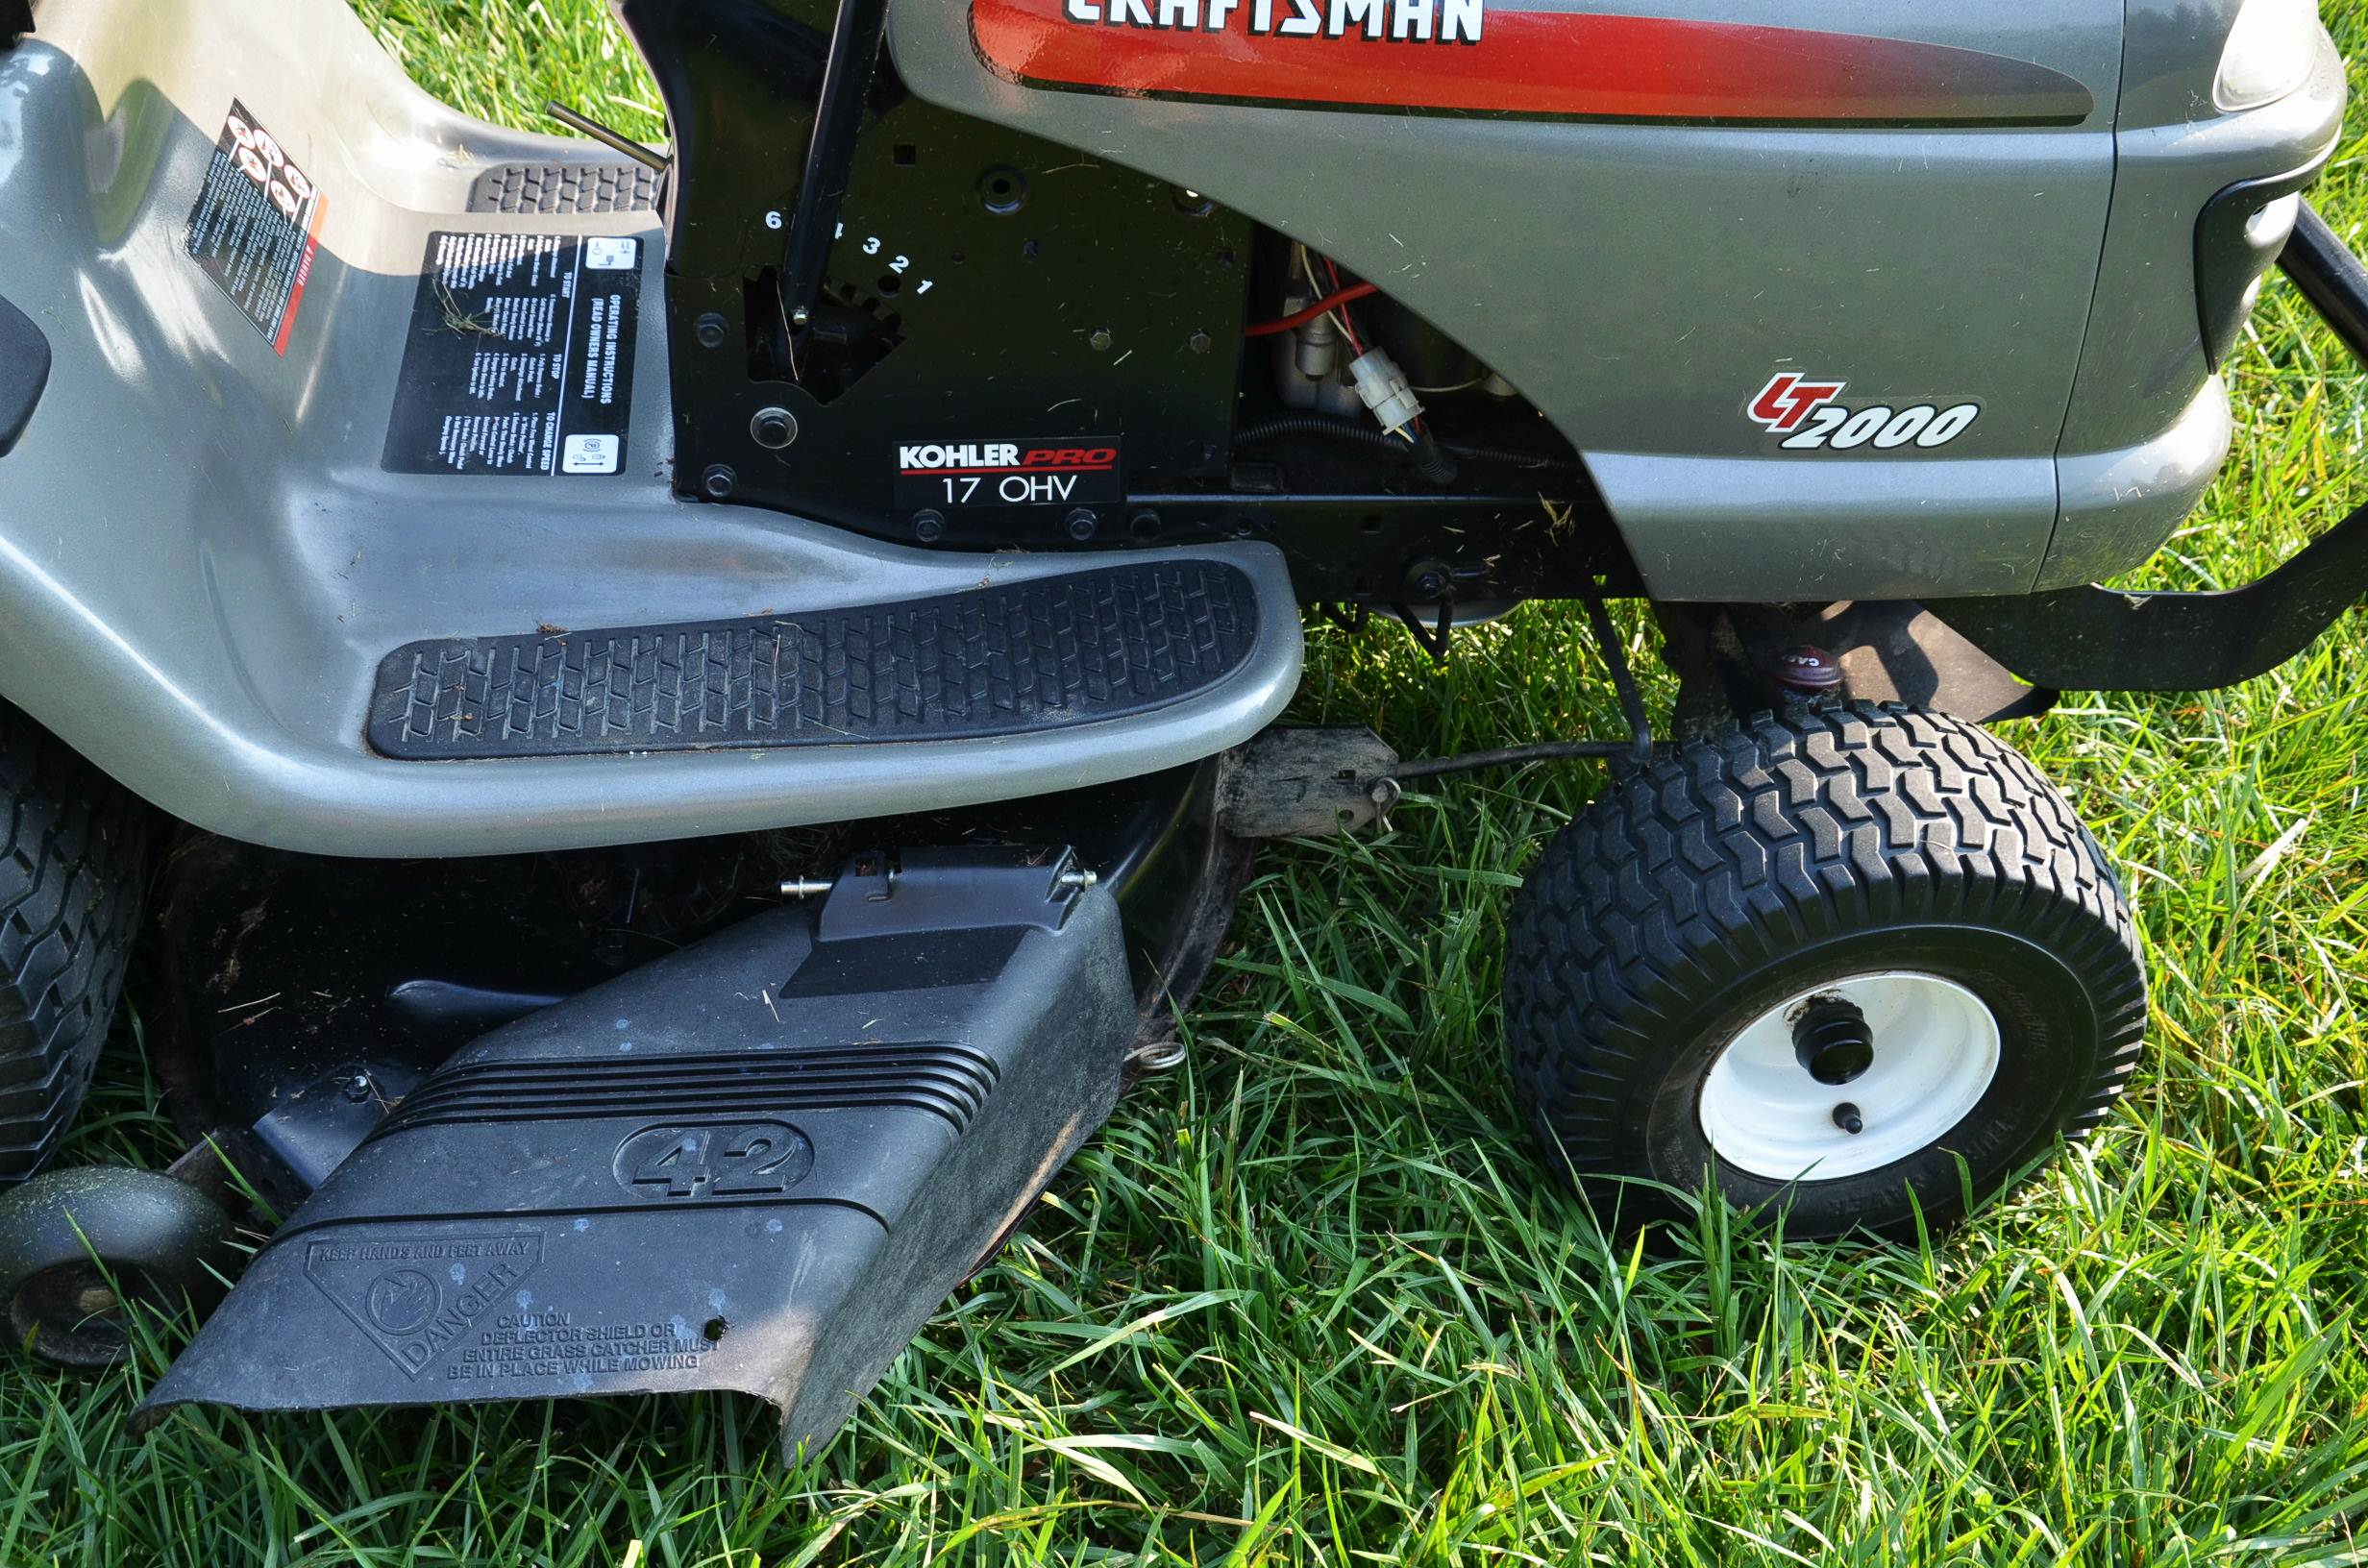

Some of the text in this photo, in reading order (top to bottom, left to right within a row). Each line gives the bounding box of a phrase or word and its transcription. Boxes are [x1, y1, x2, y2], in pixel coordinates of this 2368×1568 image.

[765, 211, 933, 294] 6 3 2 1
[561, 281, 571, 298] START
[581, 298, 604, 398] (READ OWNERS MANUAL)
[600, 295, 621, 404] OPERATING INSTRUCTIONS
[551, 354, 562, 379] TO STOP
[1749, 373, 1980, 450] LT 2000
[540, 412, 555, 470] TO CHANGE SPEED
[900, 444, 1118, 469] KOHLER PRO
[943, 475, 1078, 503] 17 OHV
[631, 1125, 799, 1198] 42
[320, 1240, 528, 1262] KEEP HANDS AND FEET AWAY
[402, 1262, 519, 1367] DANGER
[497, 1312, 570, 1329] CAUTION
[481, 1323, 675, 1345] DEFLECTOR SHIELD OR
[464, 1337, 720, 1362] ENTIRE GRASS CATCHER MUST
[447, 1355, 700, 1380] BE IN PLACE WHILE MOWING
